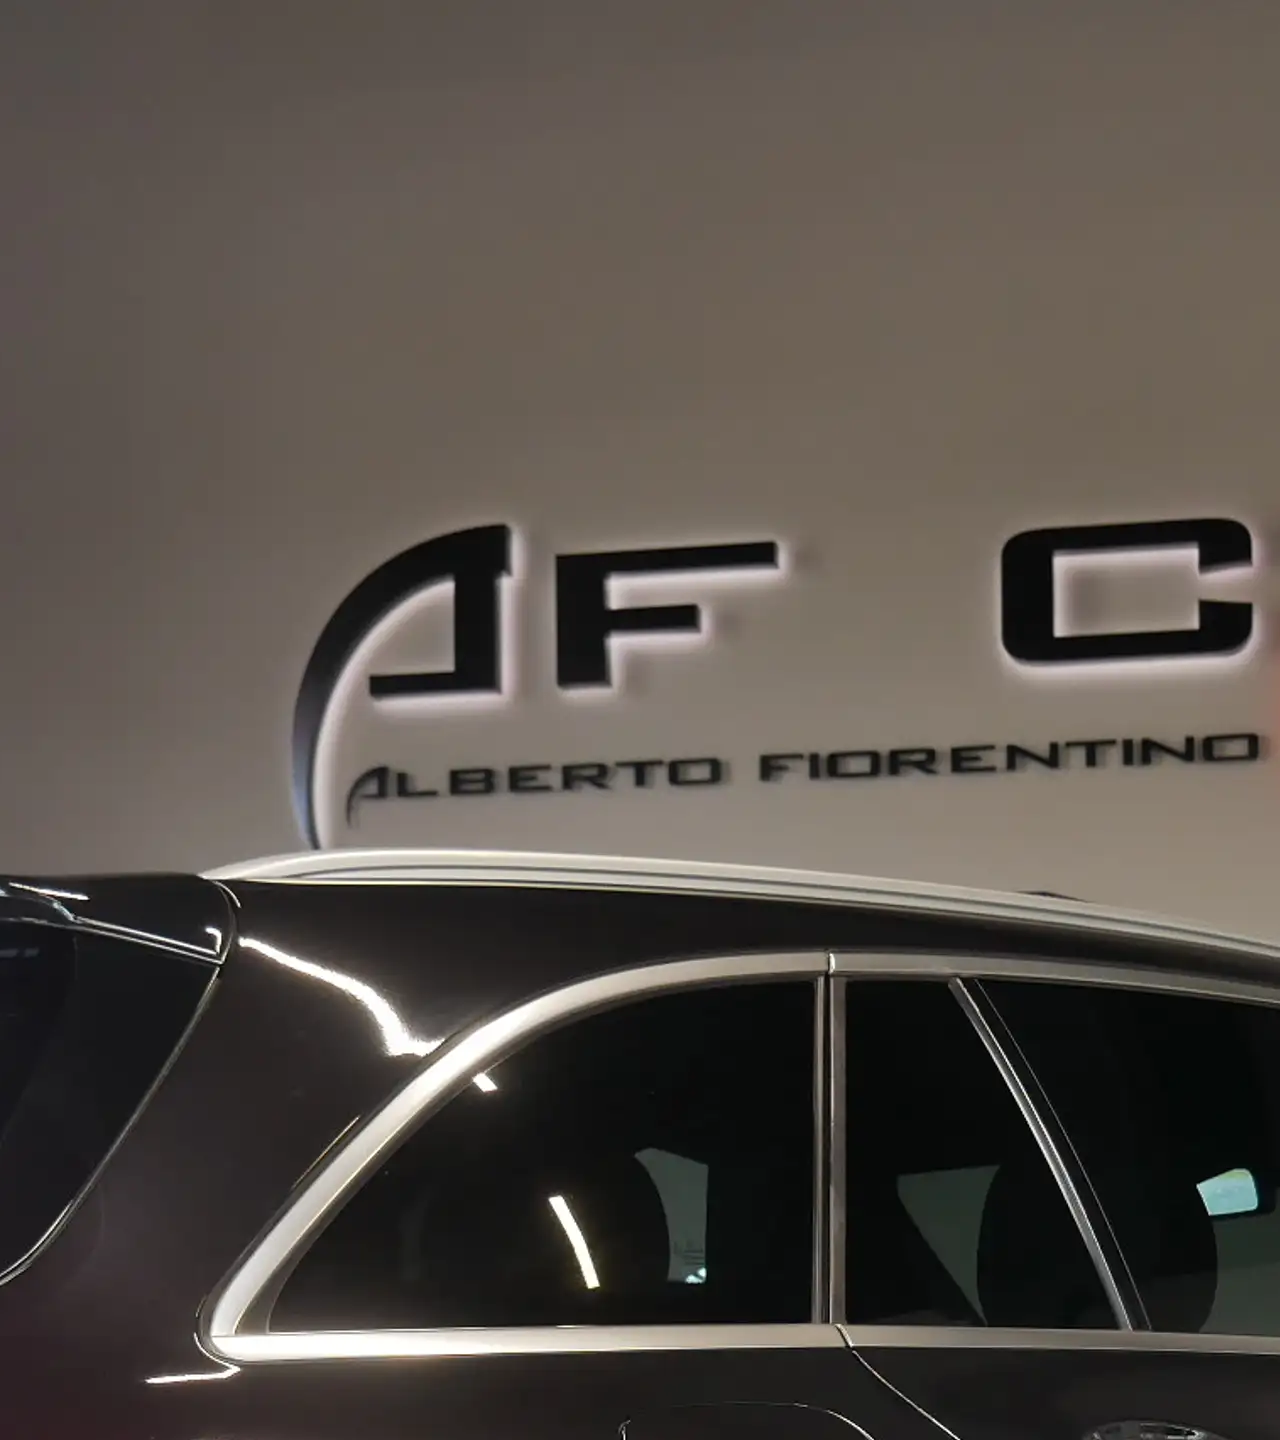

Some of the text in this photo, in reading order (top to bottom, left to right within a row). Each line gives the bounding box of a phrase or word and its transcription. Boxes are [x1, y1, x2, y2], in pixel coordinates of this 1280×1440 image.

[292, 523, 780, 849] AF
[345, 758, 721, 830] ALBERTO
[758, 732, 1261, 784] FIORENTINO
